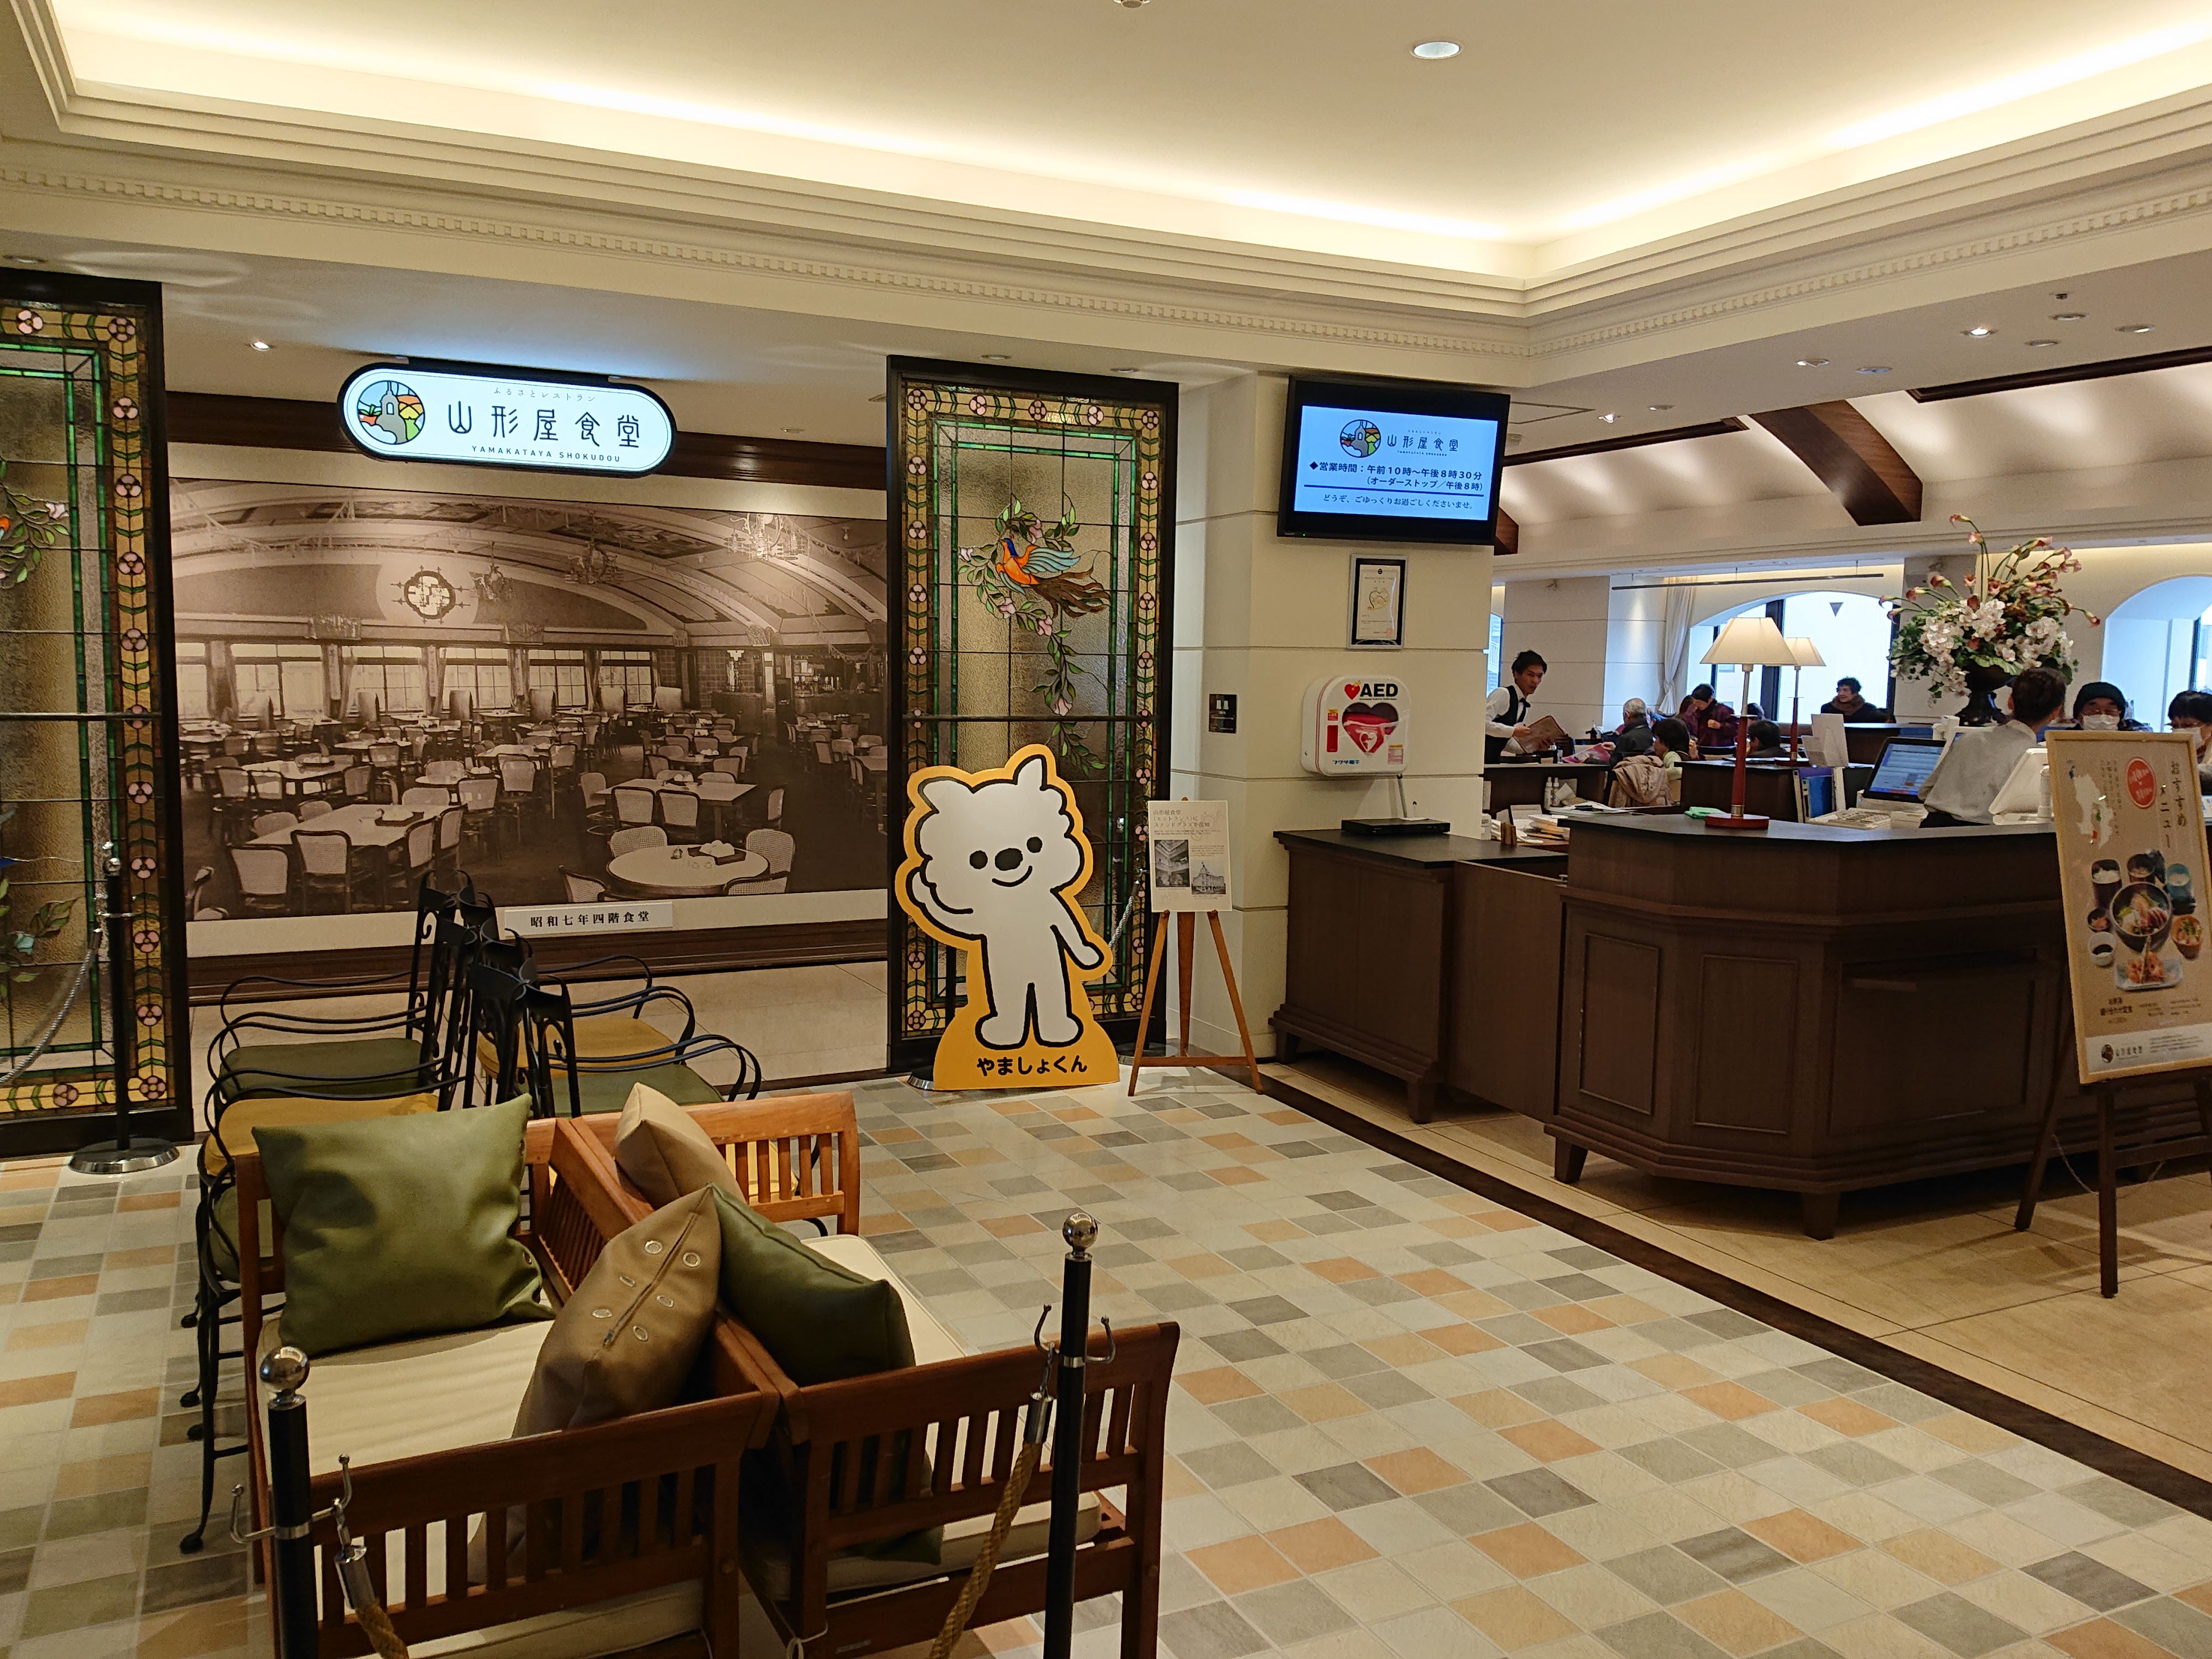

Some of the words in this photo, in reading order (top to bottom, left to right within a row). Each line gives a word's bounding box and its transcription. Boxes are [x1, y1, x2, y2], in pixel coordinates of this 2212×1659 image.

[493, 388, 596, 402] ふるさとレストラン
[447, 400, 640, 448] 山形屋食堂
[1387, 434, 1459, 452] 山形屋食堂
[472, 445, 552, 457] YAMAKATAYA
[559, 451, 620, 462] SHOKUDOU
[1323, 494, 1473, 510] どうぞ、ごゆっくりお過ごしくださいませ。
[1359, 683, 1399, 697] AED
[530, 910, 650, 928] 昭和七年四階食堂
[976, 1055, 1088, 1077] やましょくん
